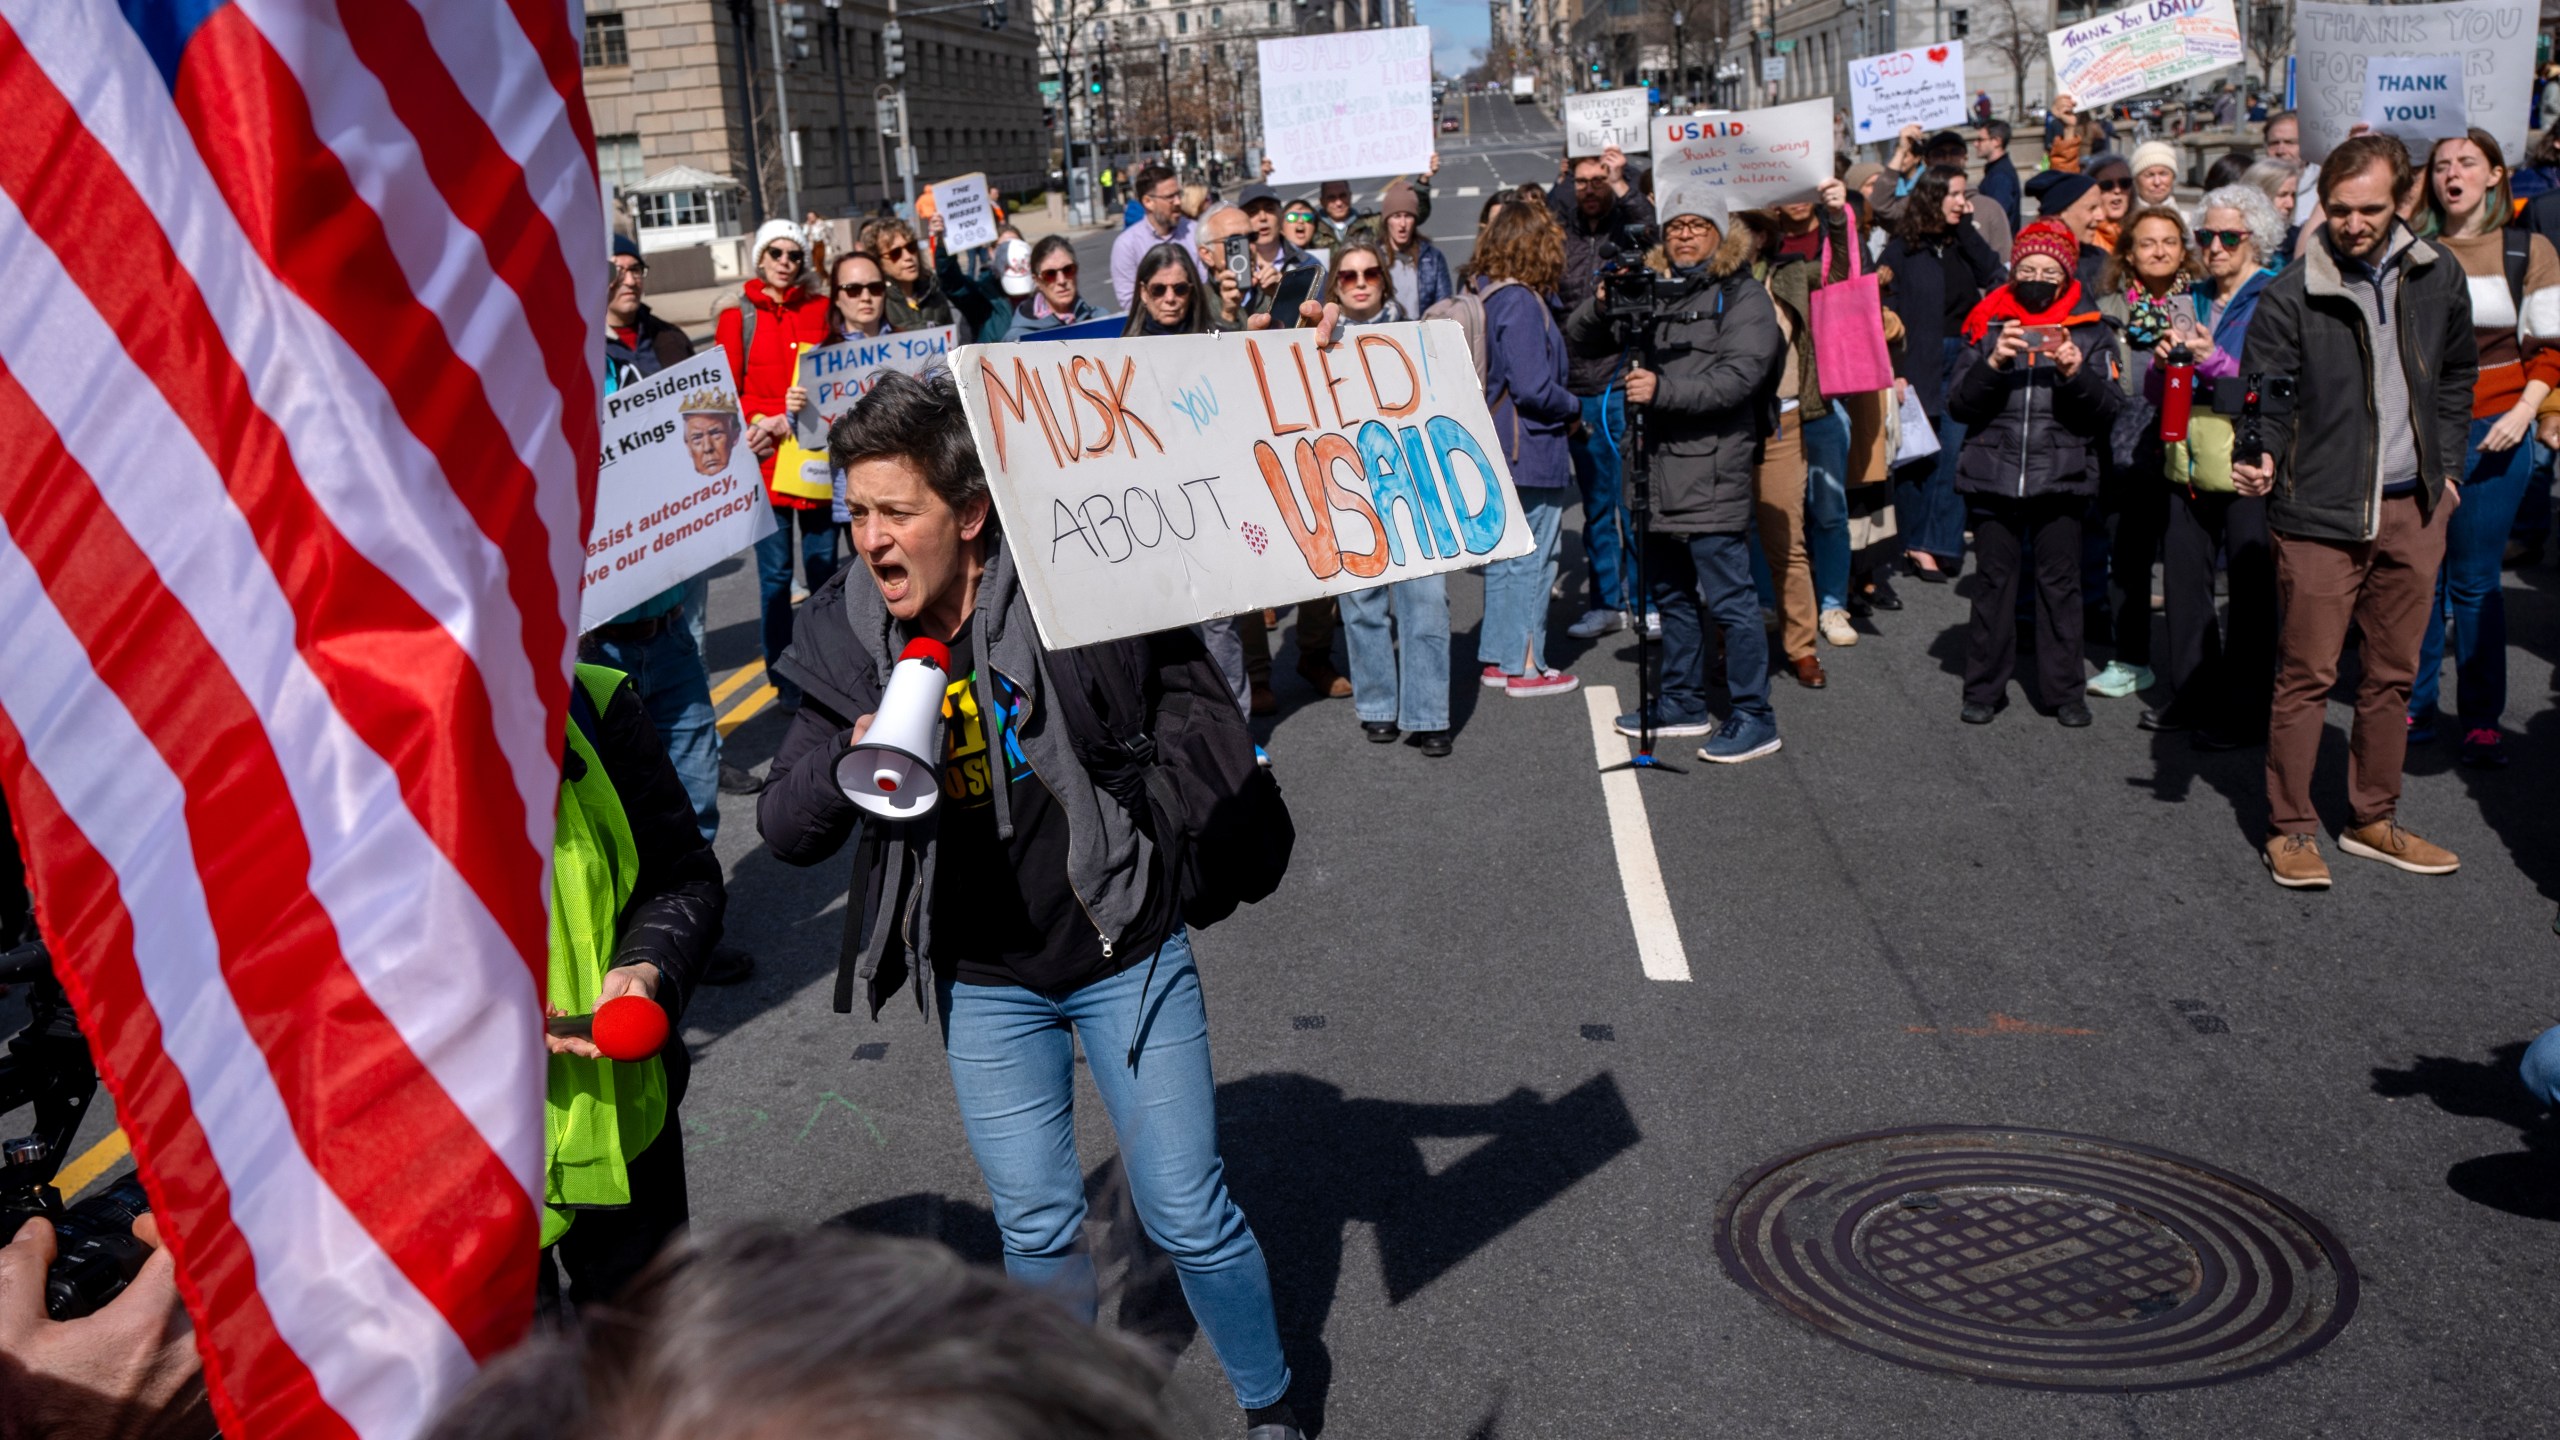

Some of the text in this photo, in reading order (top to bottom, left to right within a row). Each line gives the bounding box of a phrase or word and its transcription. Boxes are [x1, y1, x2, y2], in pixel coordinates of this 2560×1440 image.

[2062, 23, 2112, 48] THANK
[2306, 8, 2522, 44] THANK YOU
[1265, 30, 1376, 73] USAID
[1854, 52, 1915, 88] USAID
[2310, 50, 2367, 83] FOR
[2377, 74, 2448, 91] THANK
[1571, 95, 1636, 111] DESTROYING
[1584, 107, 1630, 120] USAID
[2384, 105, 2436, 121] YOU!
[1283, 117, 1345, 155] MAKE
[1577, 125, 1638, 148] DEATH
[1678, 140, 1810, 163] Thanks for caring
[1690, 159, 1792, 176] about women
[1732, 174, 1790, 185] children
[947, 194, 980, 209] WORLD
[951, 184, 970, 196] THE
[949, 205, 982, 220] MISSES
[958, 218, 978, 229] YOU
[808, 330, 953, 377] THANK YOU!
[608, 367, 722, 419] Presidents
[979, 354, 1166, 474] MUSK
[1171, 374, 1220, 436] YOU
[618, 417, 676, 456] Kings
[1050, 415, 1507, 580] ABOUT USAID
[586, 473, 738, 558] esist autocracy,
[616, 544, 648, 571] our
[652, 484, 760, 555] democracy!
[1981, 1247, 2073, 1276] SEWER
